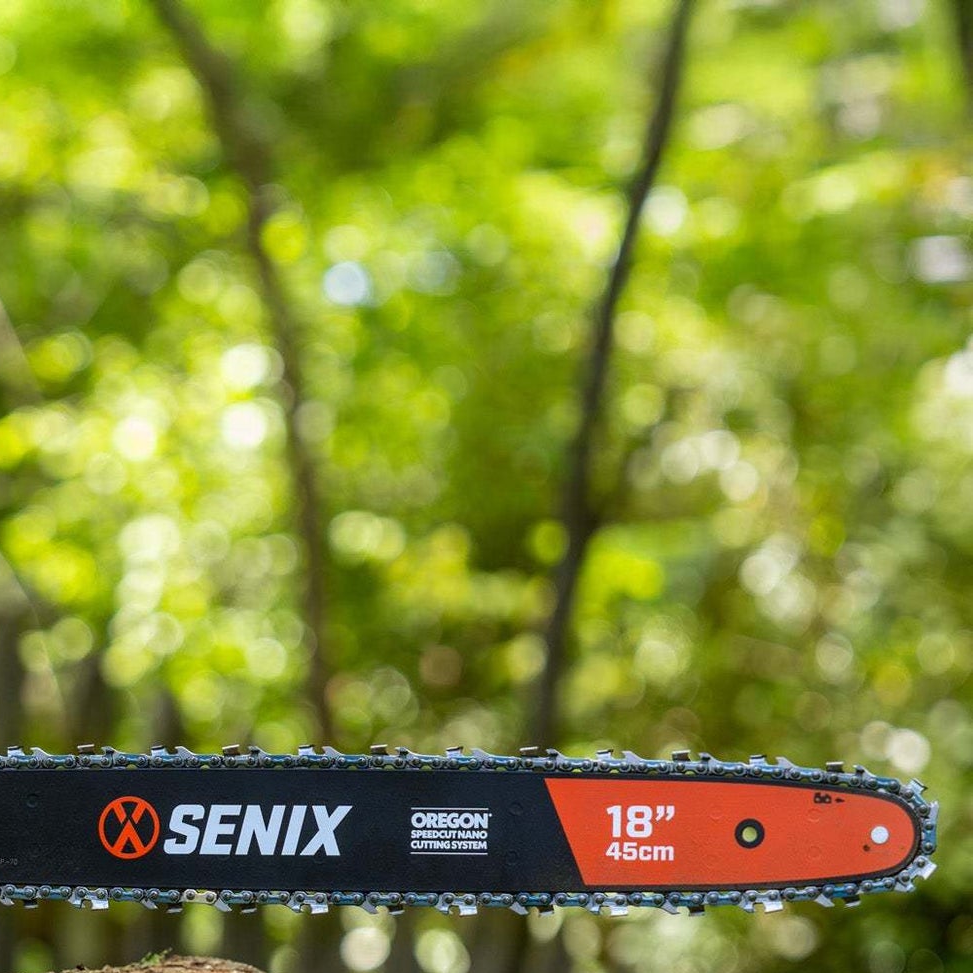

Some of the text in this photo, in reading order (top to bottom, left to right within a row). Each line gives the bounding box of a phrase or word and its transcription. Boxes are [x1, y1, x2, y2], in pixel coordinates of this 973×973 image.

[411, 812, 488, 828] OREGON
[163, 804, 352, 856] SENIX
[411, 830, 488, 839] SPEEDCUT NANO
[411, 840, 487, 849] CUTTING SYSTEM
[606, 842, 674, 861] 45cm
